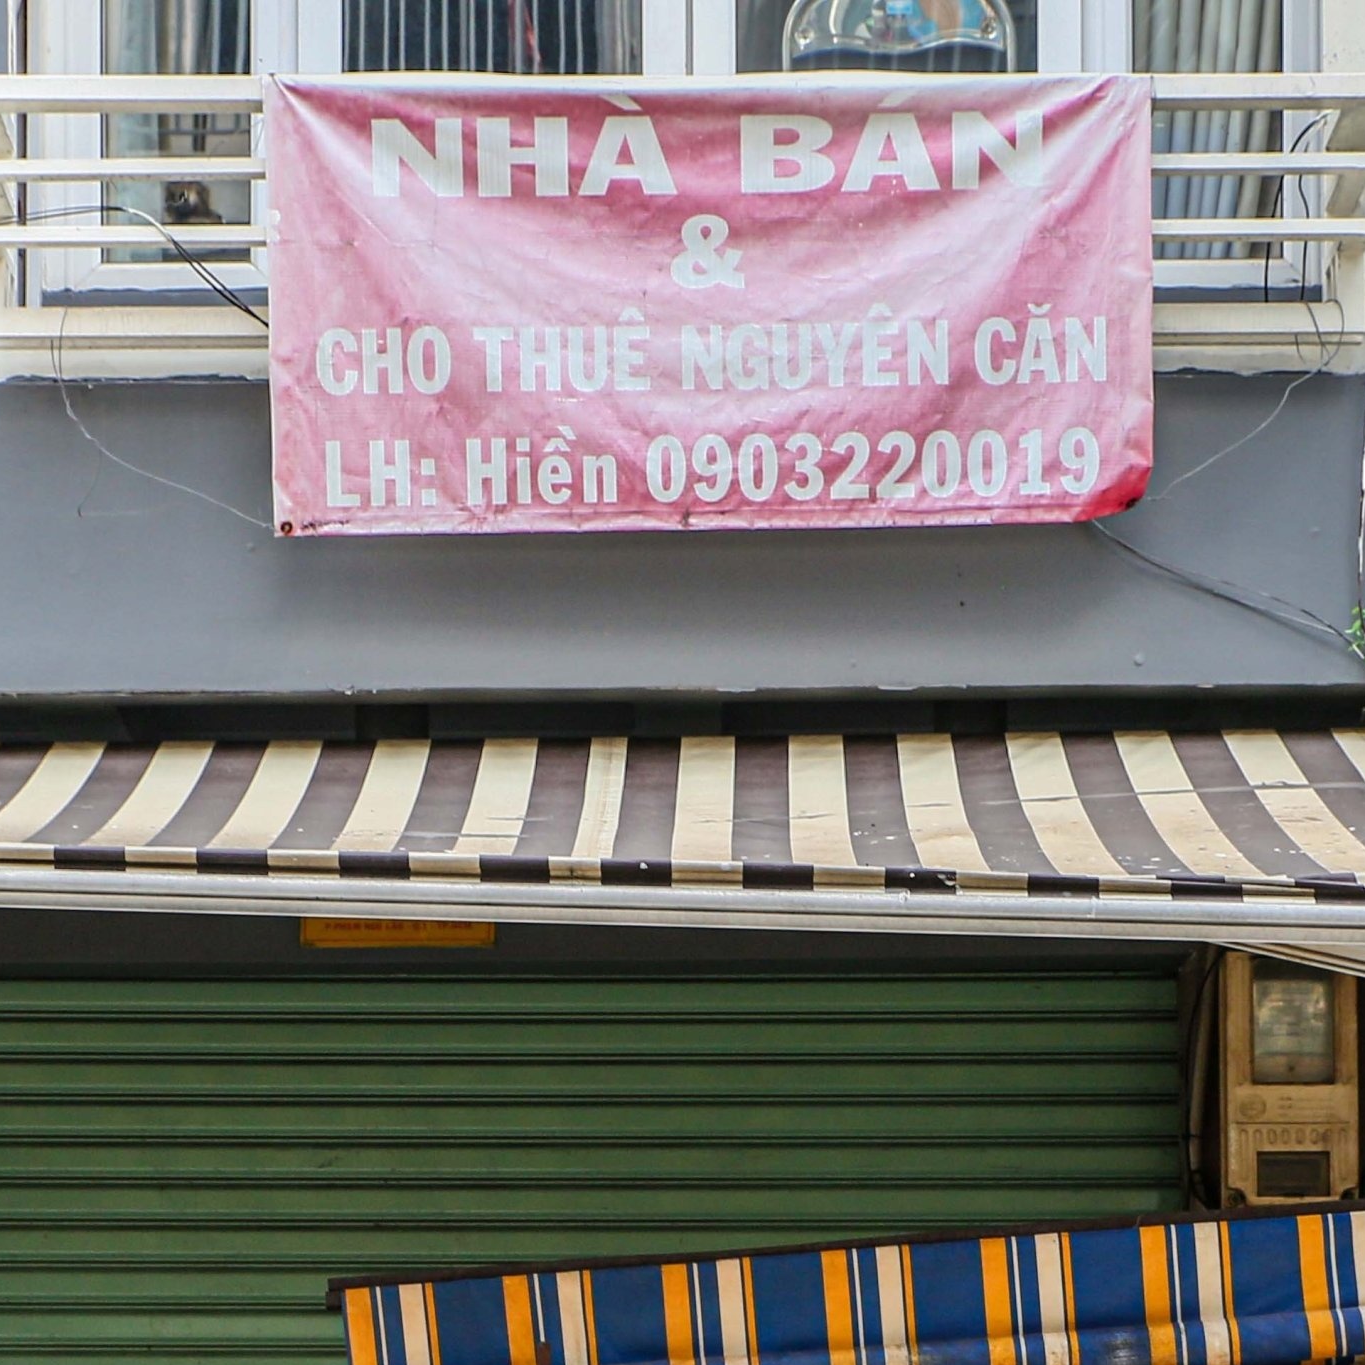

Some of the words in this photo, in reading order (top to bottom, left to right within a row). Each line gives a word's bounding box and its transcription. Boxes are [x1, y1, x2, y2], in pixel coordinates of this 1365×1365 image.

[370, 93, 676, 198] NHÀ
[740, 91, 1046, 195] BÁN
[669, 213, 746, 290] &
[315, 324, 453, 397] CHO
[473, 307, 652, 393] THUÊ
[679, 302, 950, 392] NGUYÊN
[972, 302, 1109, 386] CĂN
[324, 438, 439, 508] LH:
[466, 425, 619, 505] Hiền
[645, 426, 1102, 504] 0903220019
